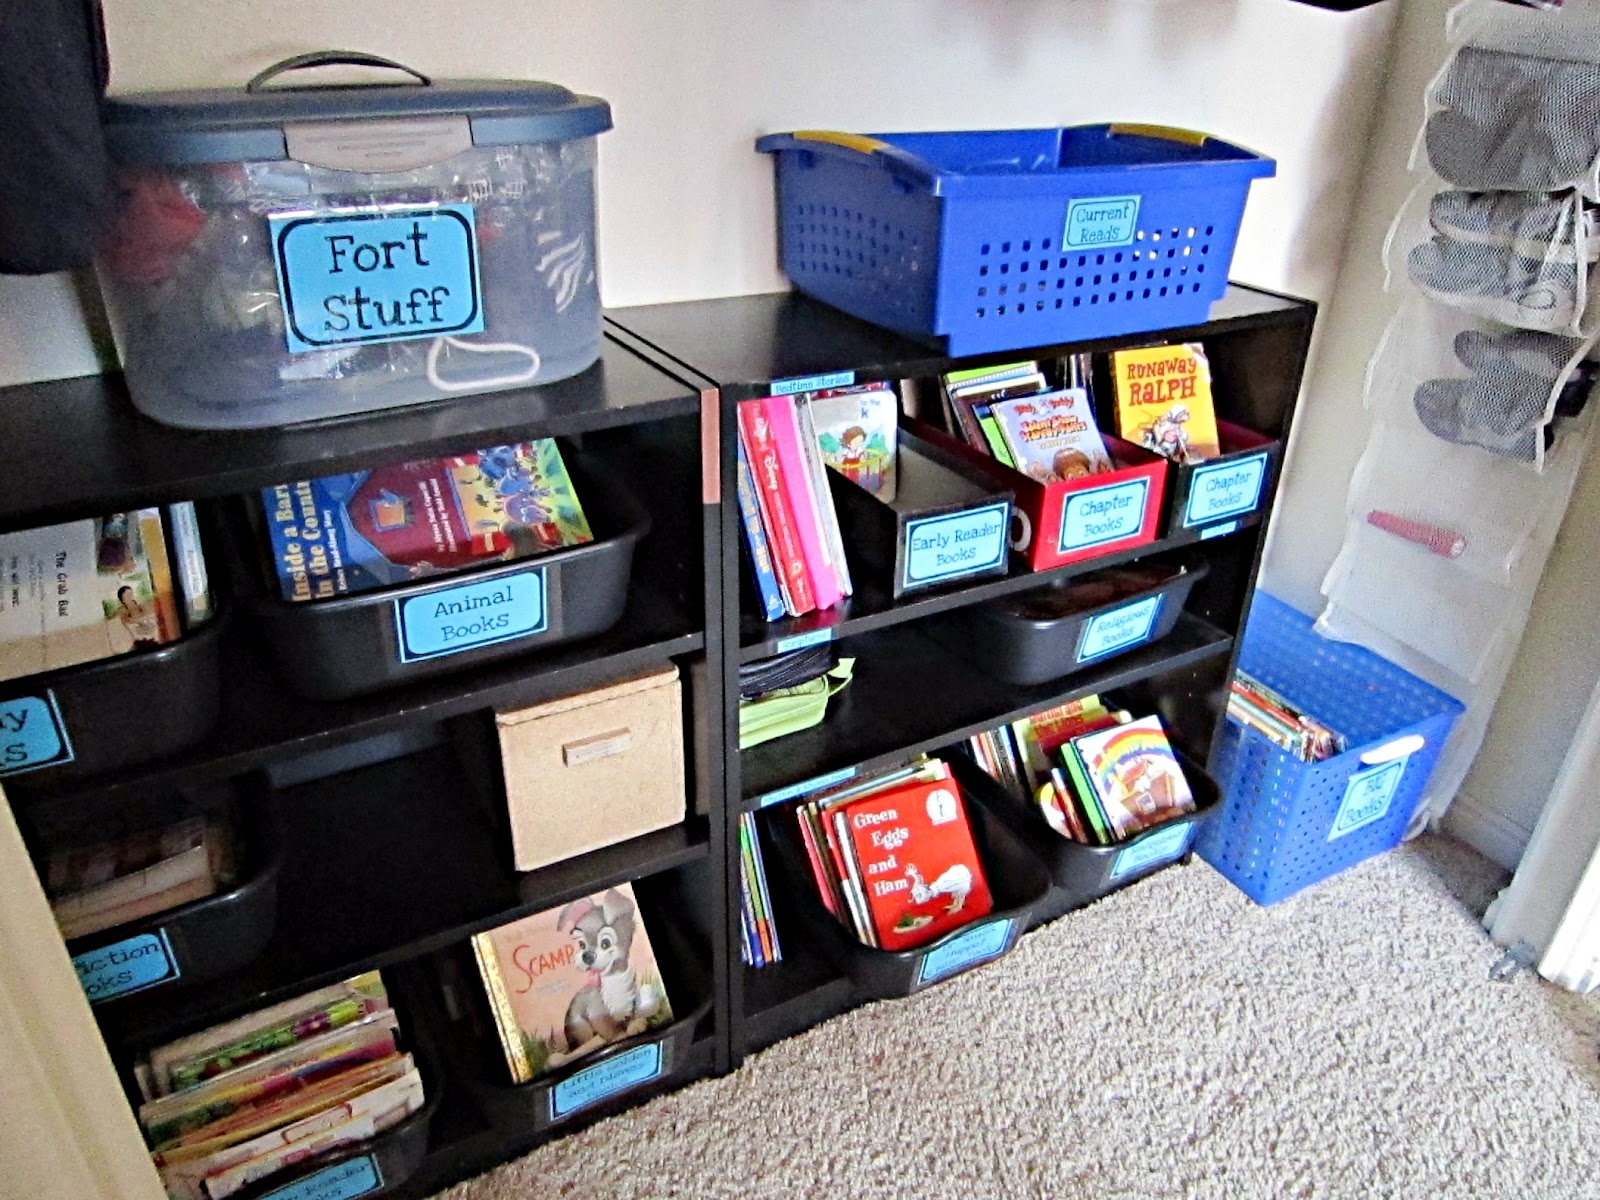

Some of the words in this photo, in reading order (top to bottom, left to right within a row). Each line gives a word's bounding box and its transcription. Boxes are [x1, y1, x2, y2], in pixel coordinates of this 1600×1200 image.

[1077, 202, 1130, 222] Current
[1080, 225, 1120, 242] Reads
[324, 221, 430, 274] Fort
[1206, 471, 1252, 493] Chapter
[294, 481, 321, 540] Countr
[1080, 494, 1133, 516] Chapter
[1208, 492, 1243, 511] Books
[912, 532, 950, 551] Early
[954, 523, 1001, 543] Reader
[1084, 517, 1124, 537] Books
[936, 546, 977, 566] Books
[284, 542, 312, 602] Inside
[433, 585, 514, 618] Animal
[441, 613, 509, 641] Books
[853, 809, 898, 828] Green
[870, 827, 909, 850] Eggs
[868, 854, 898, 874] and
[873, 878, 909, 897] Ham
[75, 943, 161, 974] iction
